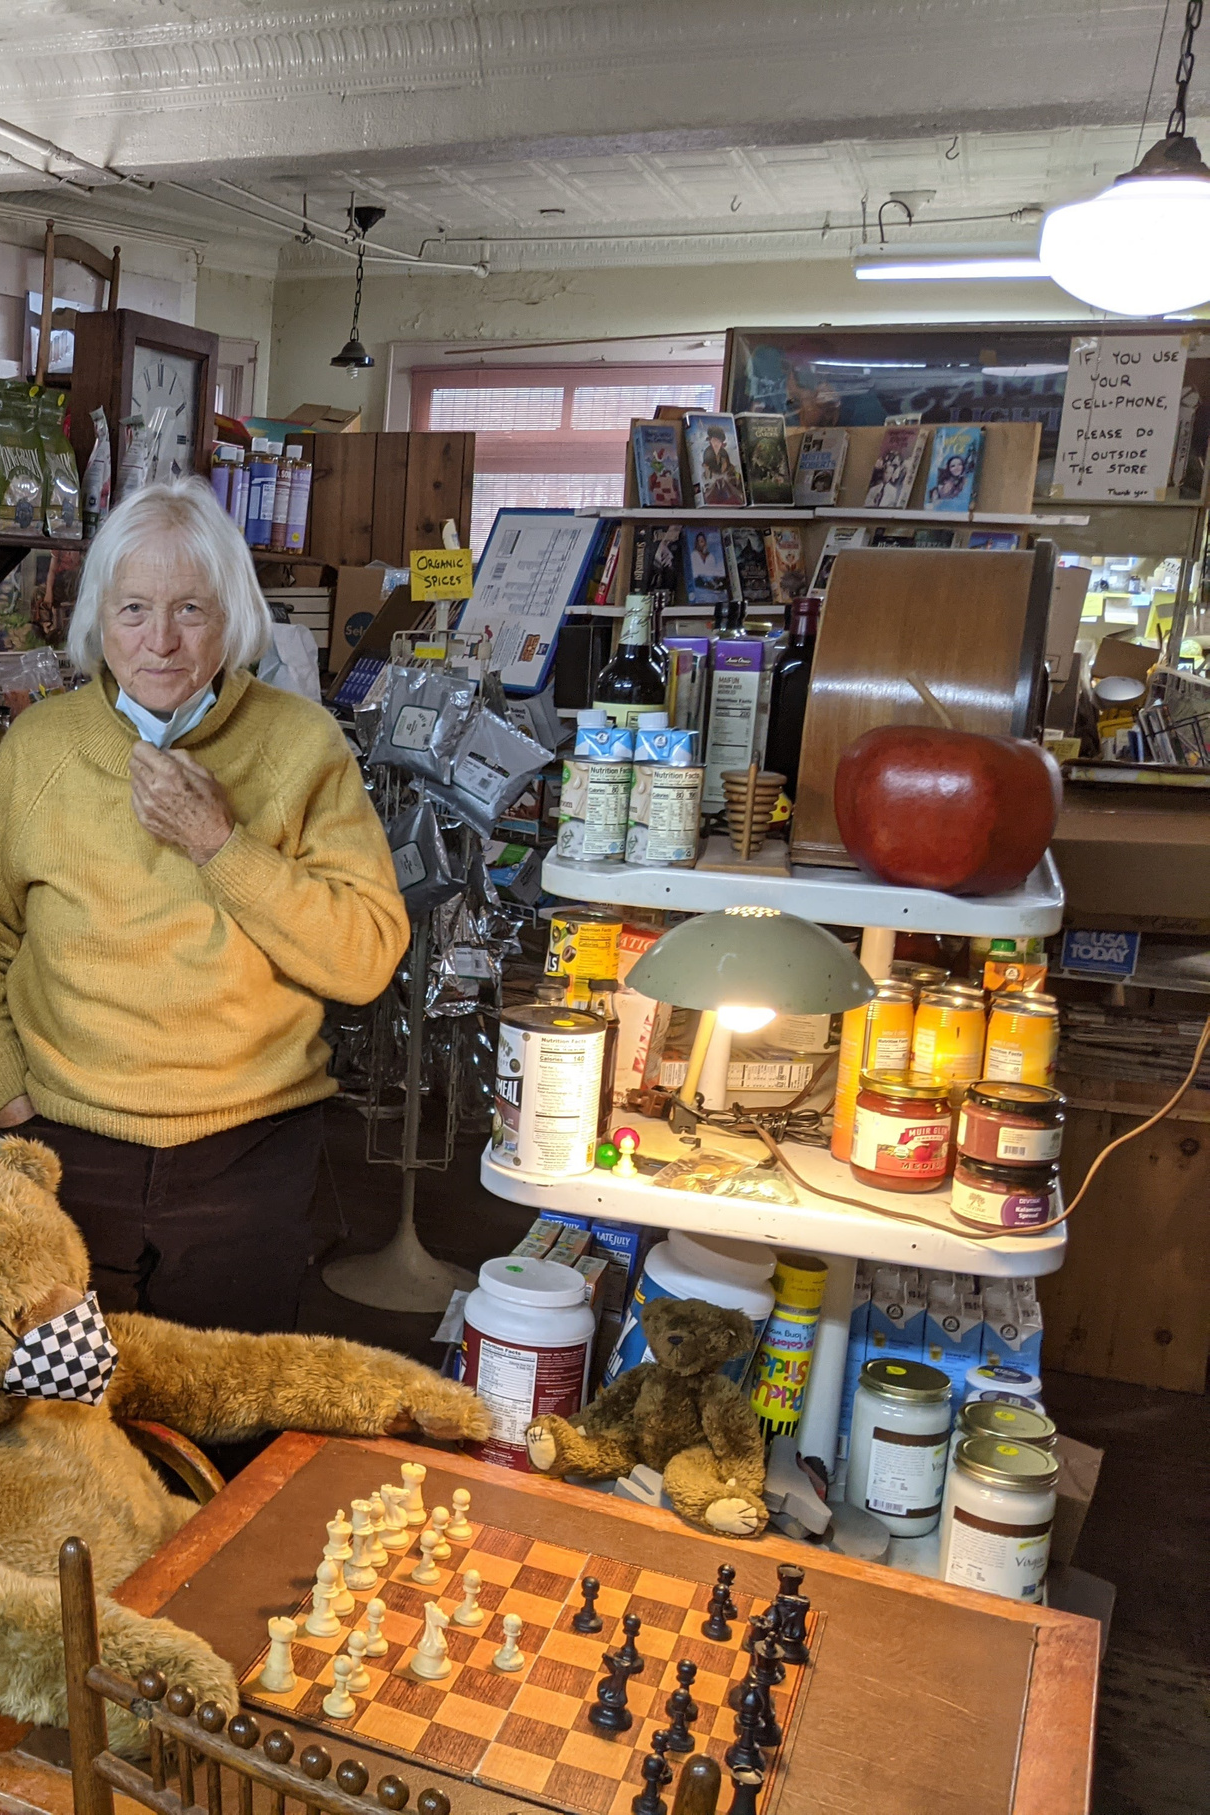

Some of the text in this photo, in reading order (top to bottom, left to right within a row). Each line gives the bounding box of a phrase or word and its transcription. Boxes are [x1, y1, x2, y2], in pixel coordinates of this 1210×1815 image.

[1078, 351, 1180, 365] IF YOU USE
[1091, 373, 1132, 388] YOUR
[1071, 396, 1168, 411] CELL-PHONE,
[1077, 428, 1154, 441] PLEASE DO
[801, 452, 832, 462] MISTER
[1062, 449, 1148, 462] IT OUTSIDE
[800, 460, 836, 470] ROBERTS
[1069, 464, 1148, 474] THE STORE
[416, 556, 464, 570] ORGANIC
[423, 575, 462, 589] SPICES
[590, 767, 618, 775] Nutrition
[654, 771, 700, 779] Nutrition Facts
[1091, 932, 1129, 949] USA
[1070, 944, 1130, 963] TODAY
[909, 1128, 931, 1137] MUIR
[596, 1231, 631, 1246] LATE JULY
[784, 1328, 803, 1341] long
[482, 1341, 521, 1356] Nutrition Facts
[760, 1351, 810, 1386] Sticks
